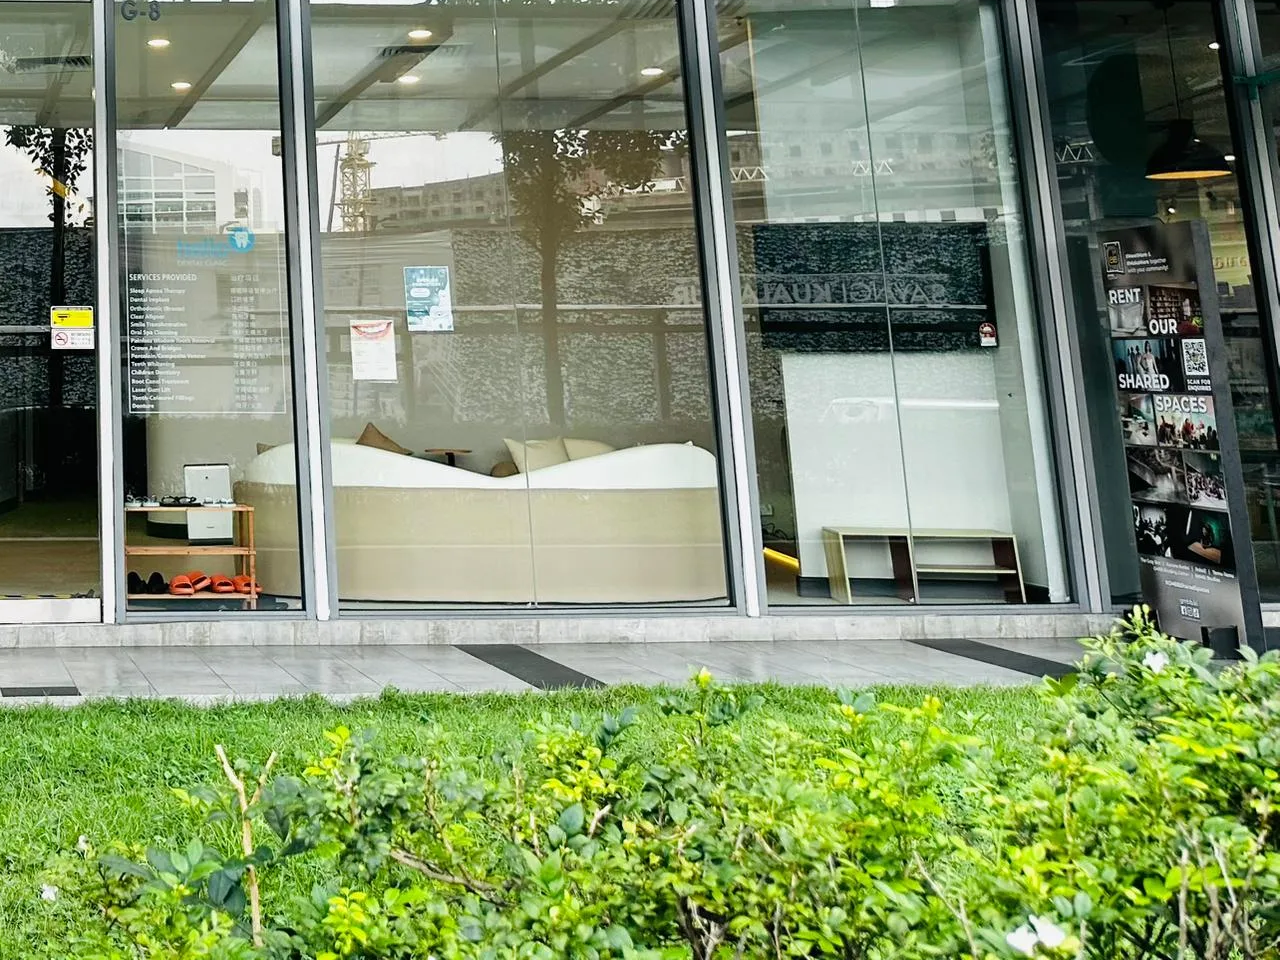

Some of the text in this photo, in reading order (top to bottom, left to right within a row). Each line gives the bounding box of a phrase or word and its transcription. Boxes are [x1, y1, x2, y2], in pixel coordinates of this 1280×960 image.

[121, 0, 161, 21] G-8
[129, 273, 197, 281] SERVICES PROVIDED
[1108, 287, 1141, 305] RENT
[1149, 318, 1178, 335] OUR
[1119, 373, 1170, 390] SHARED
[1154, 396, 1208, 414] SPACES
